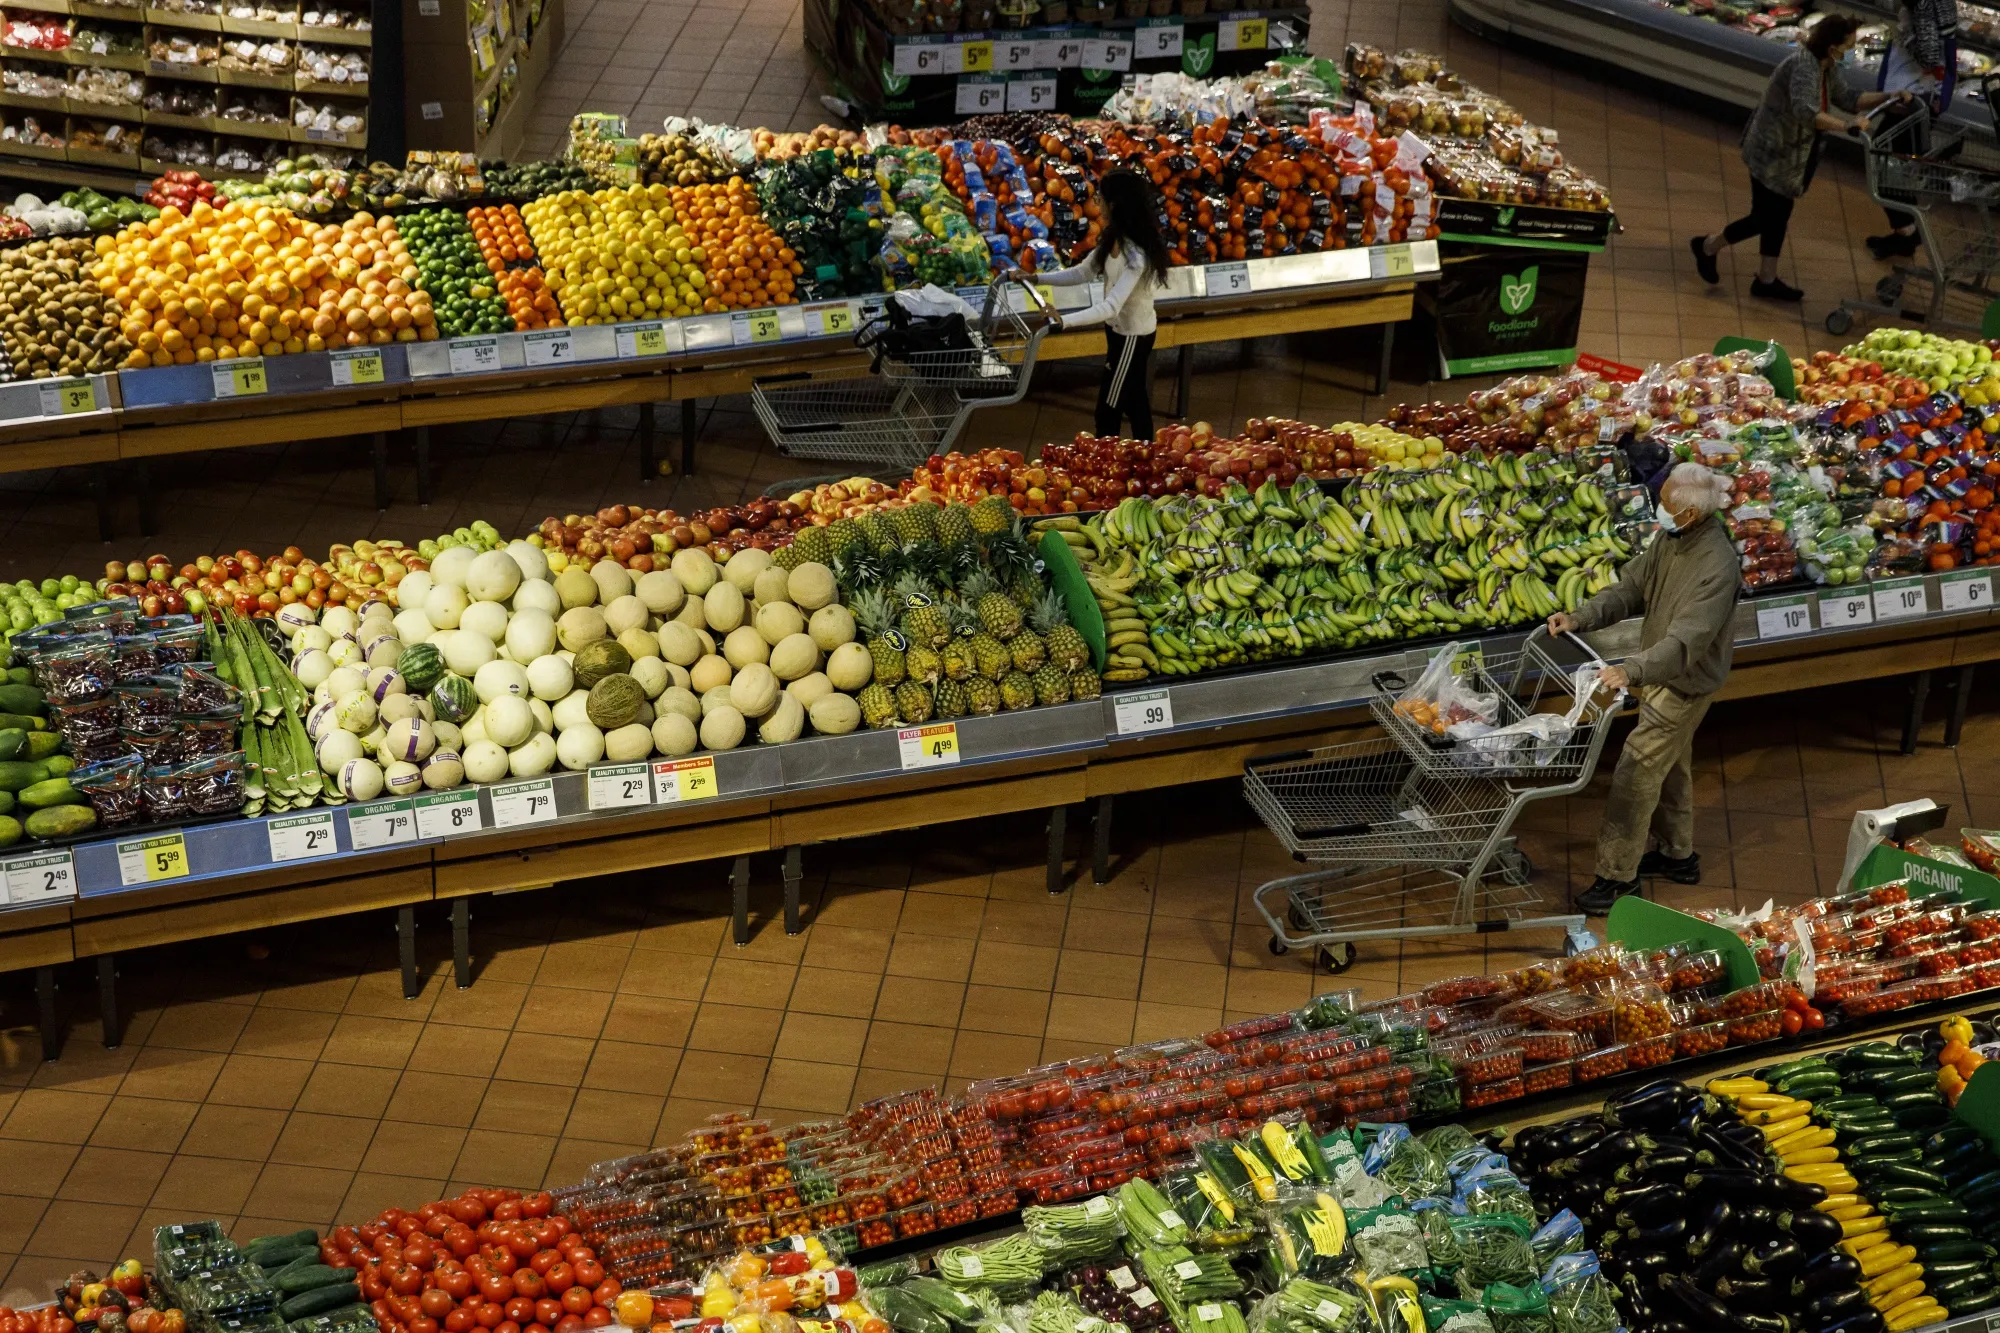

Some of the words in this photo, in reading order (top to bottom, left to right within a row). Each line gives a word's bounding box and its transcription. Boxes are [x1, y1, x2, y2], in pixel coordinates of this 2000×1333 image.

[908, 36, 930, 44] LOCAL
[1517, 219, 1533, 227] Good
[1534, 220, 1550, 229] Things
[1573, 223, 1595, 231] Ontario
[1144, 707, 1163, 724] .99
[903, 730, 921, 738] FLYER
[923, 725, 951, 736] FEATURE
[673, 762, 697, 770] Members
[595, 769, 615, 777] QUALITY
[530, 782, 546, 790] TRUST
[430, 793, 462, 804] ORGANIC
[364, 803, 396, 814] ORGANIC
[274, 820, 296, 828] QUALITY
[297, 817, 308, 825] YOU
[124, 843, 146, 852] QUALITY
[147, 840, 159, 848] YOU
[159, 837, 176, 846] TRUST
[11, 861, 34, 870] QUALITY
[47, 856, 64, 864] TRUST
[1904, 861, 1964, 895] ORGANIC
